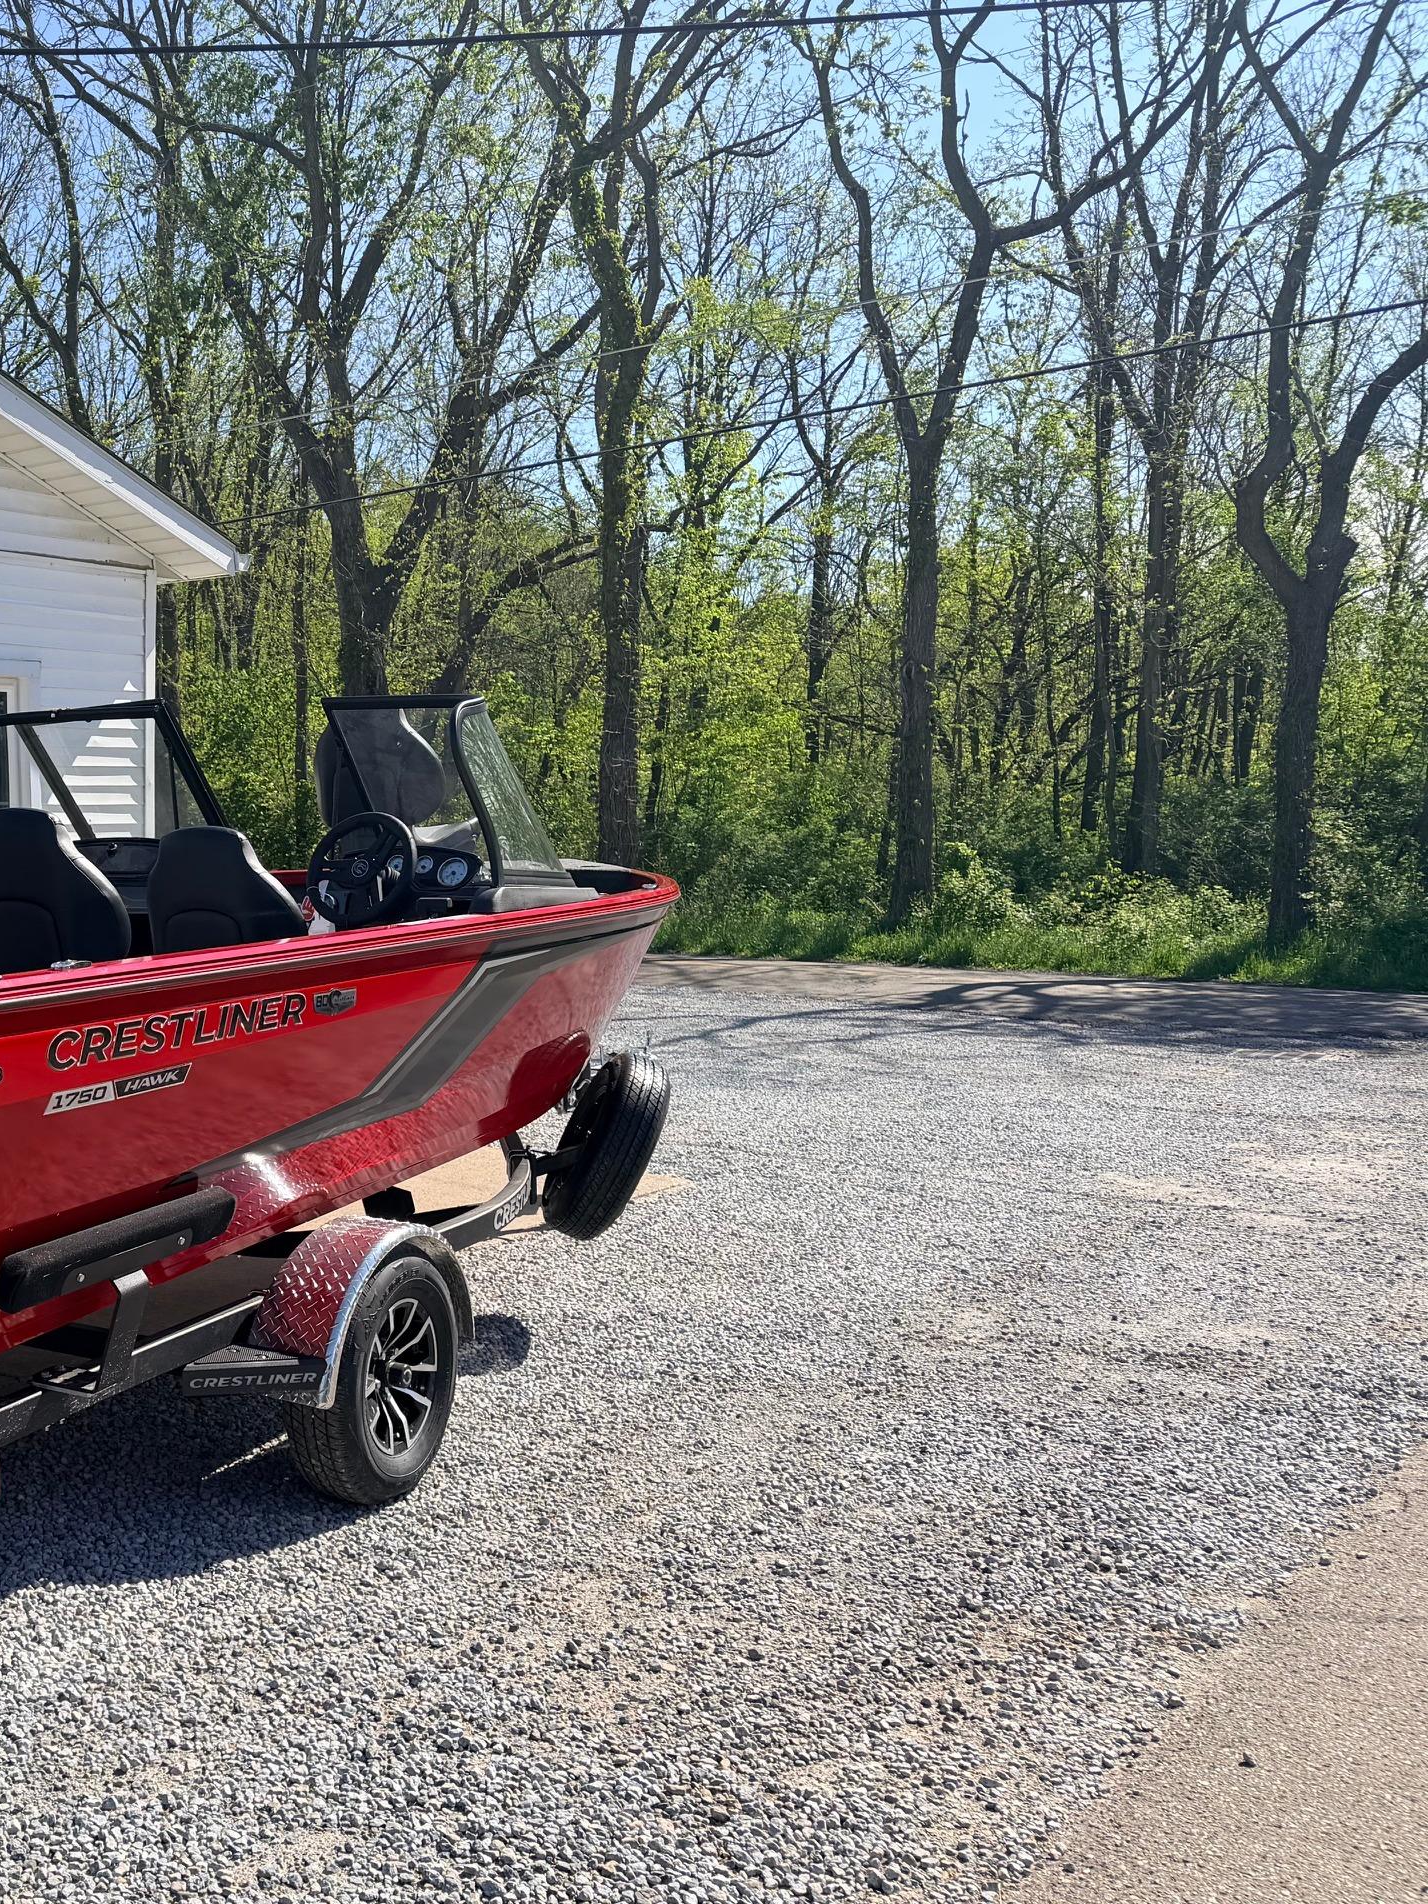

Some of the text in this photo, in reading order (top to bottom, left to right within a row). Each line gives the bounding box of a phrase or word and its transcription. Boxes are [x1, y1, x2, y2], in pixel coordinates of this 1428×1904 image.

[46, 992, 307, 1072] CRESTLINER
[50, 1067, 179, 1110] 1750 HAWK
[189, 1372, 318, 1389] CRESTLINER
